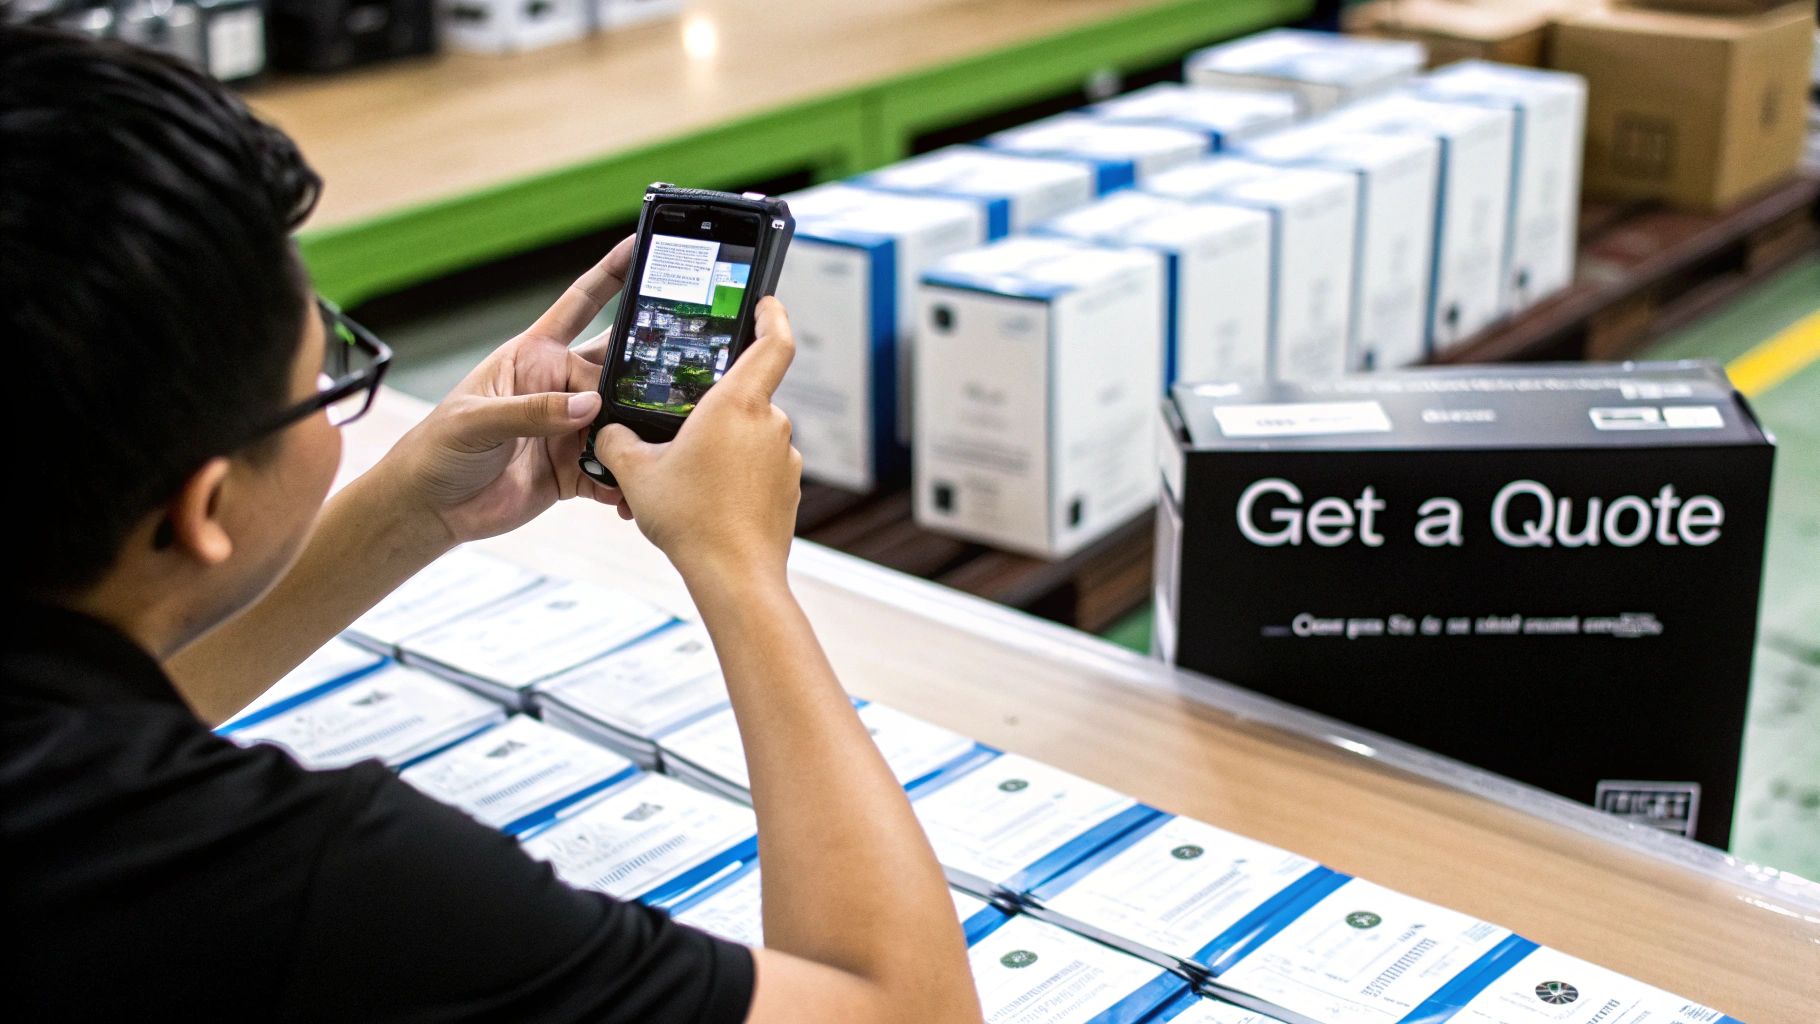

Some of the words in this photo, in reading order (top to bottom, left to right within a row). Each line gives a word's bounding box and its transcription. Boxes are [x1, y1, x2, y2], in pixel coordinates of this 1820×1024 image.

[1236, 478, 1386, 547] Get
[1414, 497, 1463, 547] a
[1491, 479, 1725, 547] Quote
